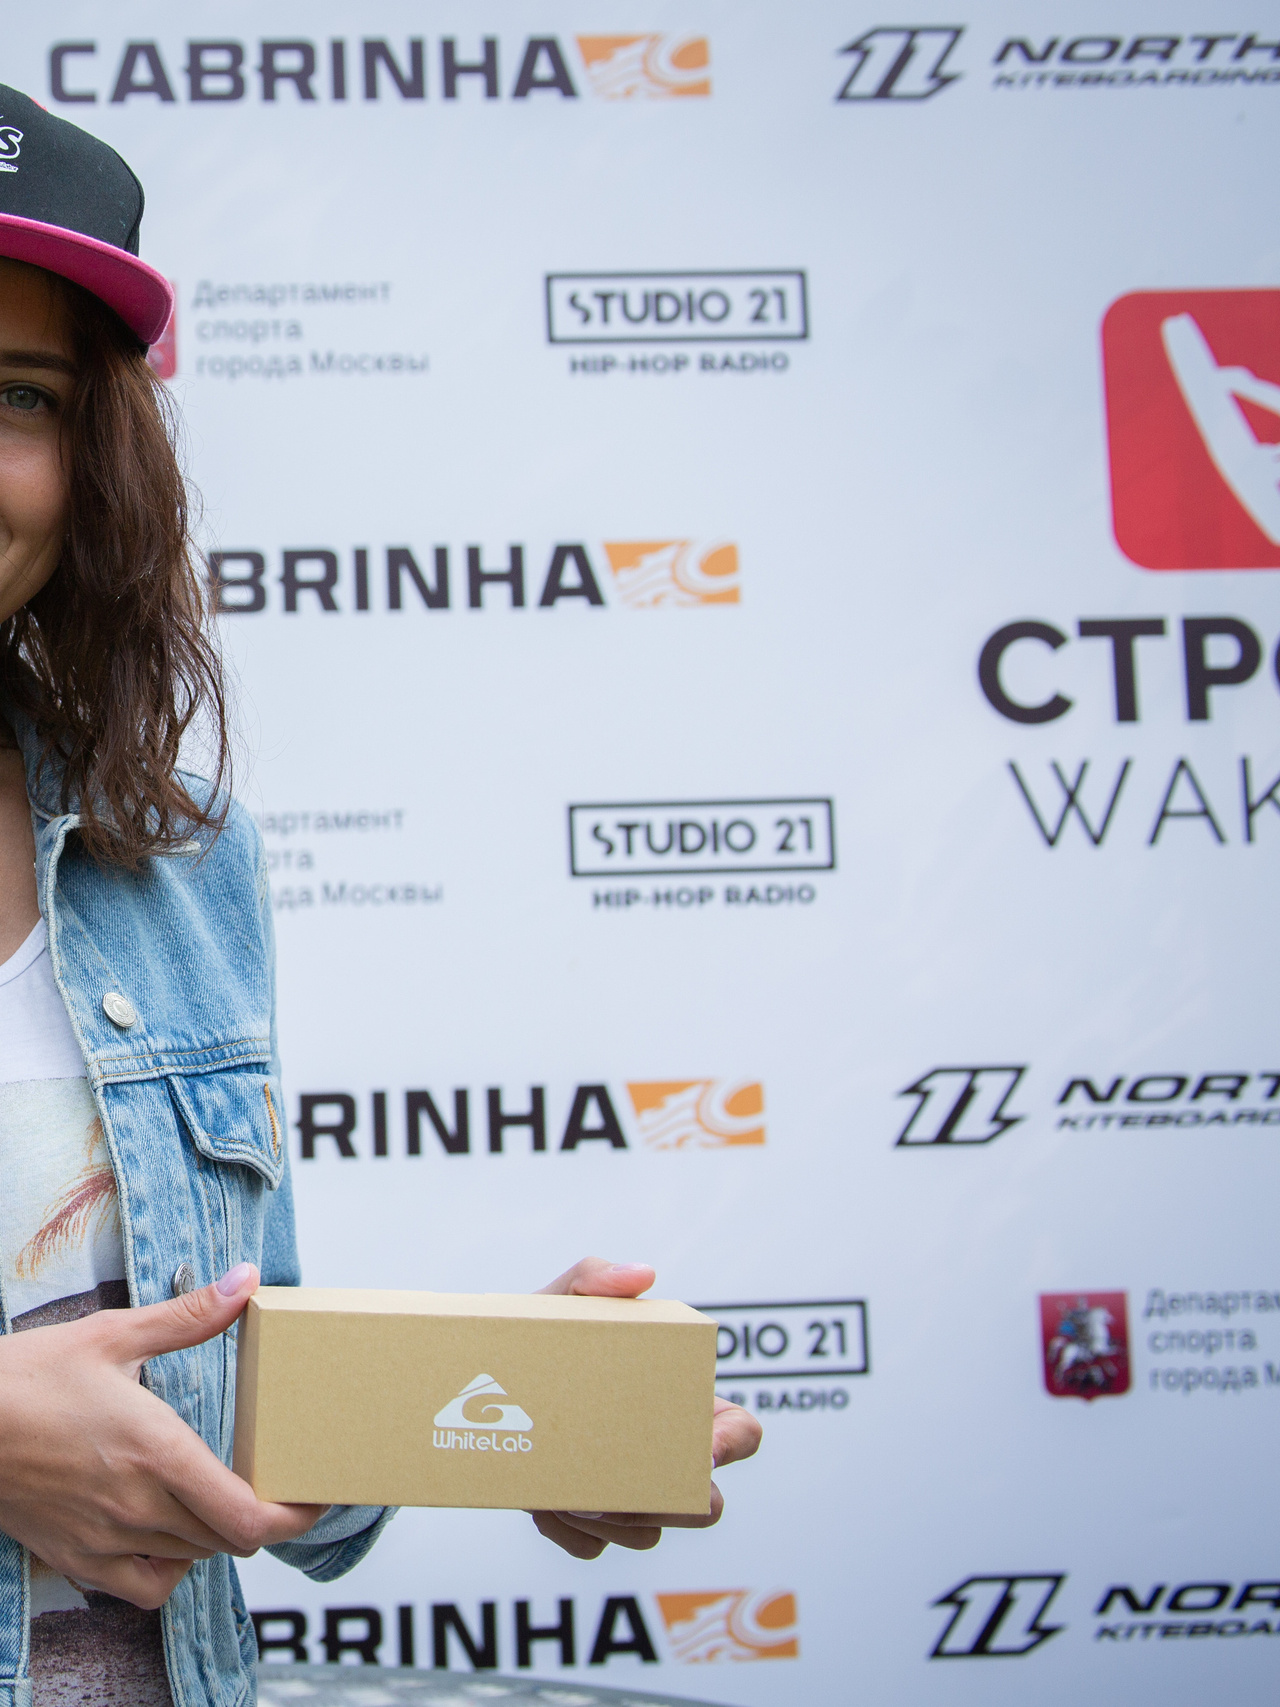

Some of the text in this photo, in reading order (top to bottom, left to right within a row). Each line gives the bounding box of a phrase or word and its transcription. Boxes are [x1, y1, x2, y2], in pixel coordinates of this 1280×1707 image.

[992, 33, 1280, 66] NORTH
[48, 34, 581, 104] CABRINHA
[192, 280, 391, 309] Департамент
[569, 287, 787, 325] STUDIO 21
[195, 318, 303, 343] спорта
[195, 349, 430, 381] города Москвы
[569, 351, 790, 375] HIP-HOP RADIO
[975, 615, 1280, 726] СТР
[1004, 753, 1280, 851] WAK
[592, 817, 813, 857] STUDIO 21
[321, 880, 443, 906] Москвы
[592, 883, 816, 909] HIP-HOP RADIO
[294, 1083, 630, 1160] RINHA
[1143, 1287, 1280, 1321] Департа
[808, 1319, 846, 1357] 21
[1147, 1328, 1258, 1358] спорта
[1149, 1365, 1260, 1396] города
[756, 1387, 850, 1412] RADIO
[432, 1430, 533, 1453] WhiteLab
[1094, 1618, 1280, 1643] KITEBOA
